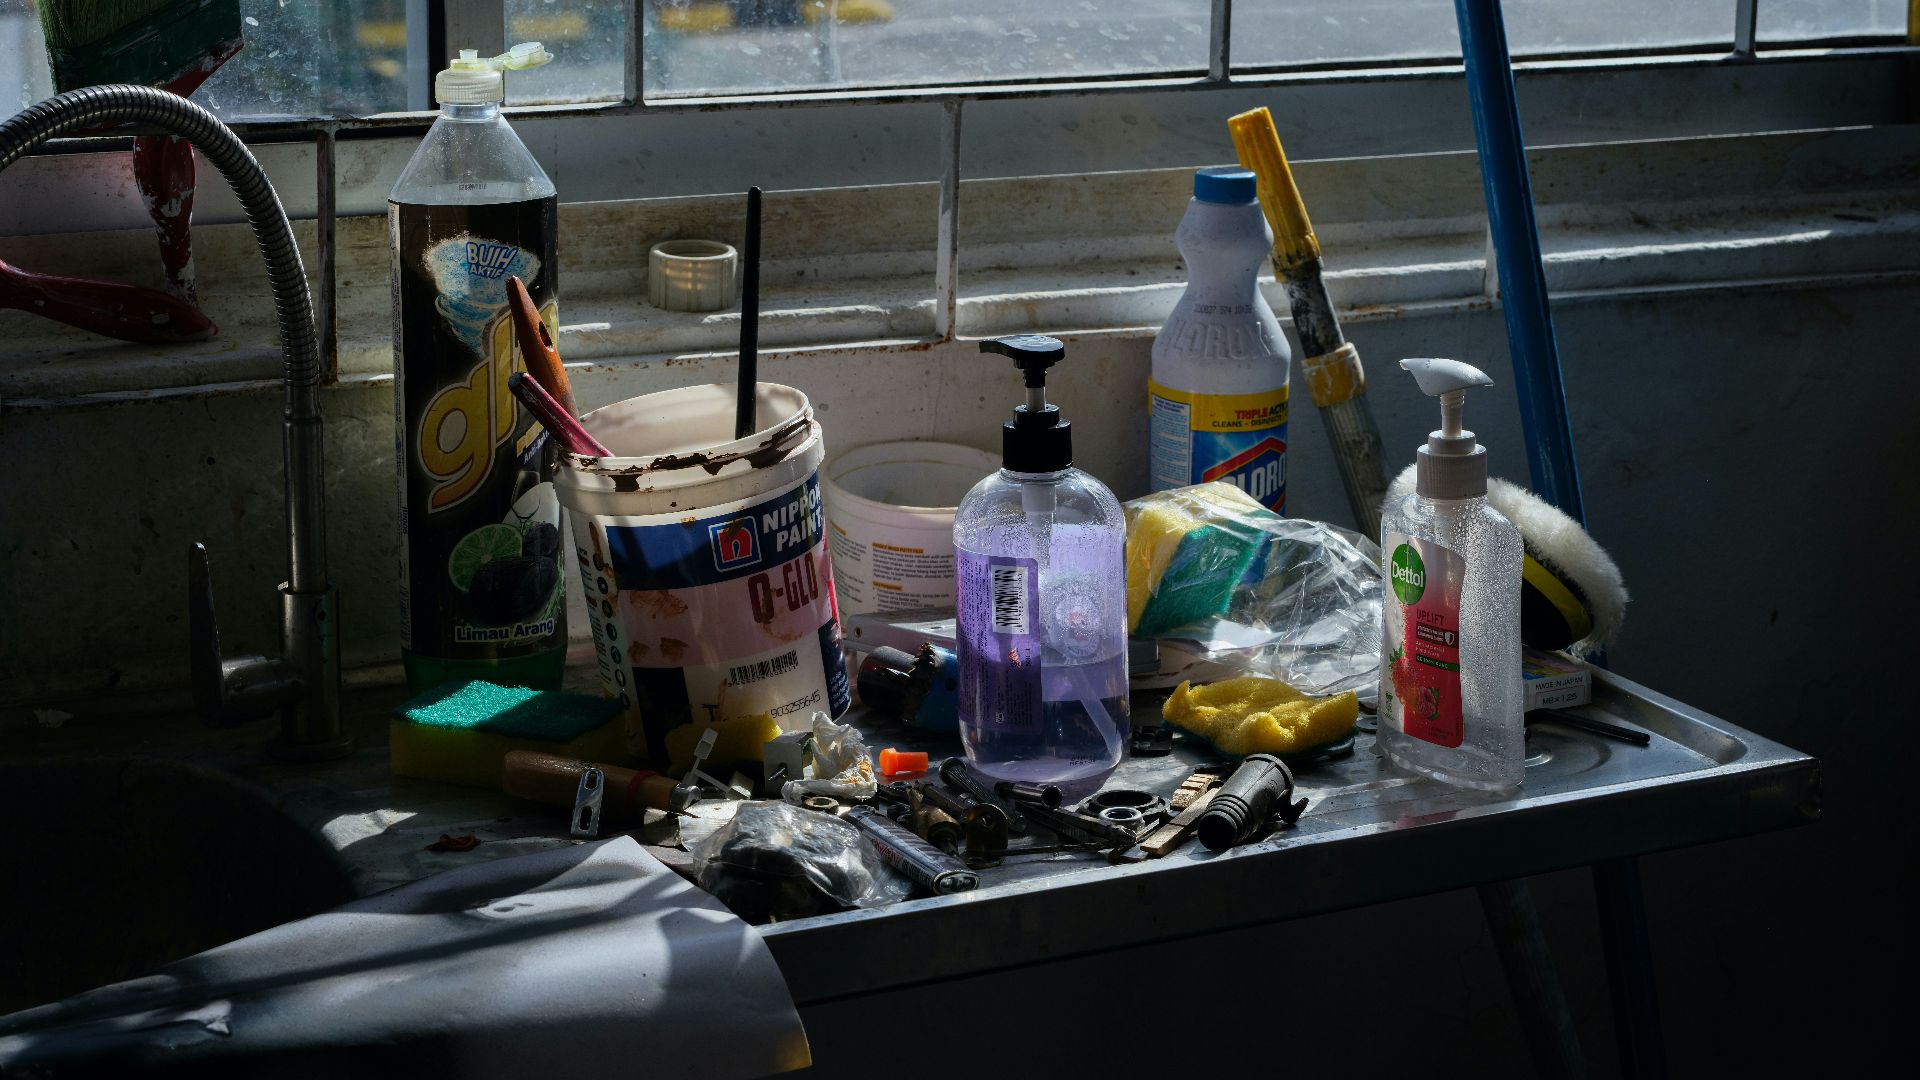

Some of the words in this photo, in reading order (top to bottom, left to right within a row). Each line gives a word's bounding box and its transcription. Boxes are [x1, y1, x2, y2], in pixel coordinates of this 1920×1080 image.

[466, 242, 519, 270] BUIH
[469, 263, 506, 279] AKTIF
[1212, 420, 1243, 428] CLEANS
[1234, 406, 1269, 421] TRIPLE
[762, 482, 821, 534] NIPPON
[776, 506, 822, 552] PAINT
[1392, 560, 1424, 589] Dettol
[747, 552, 819, 625] Q-GLO
[455, 625, 510, 642] Limau
[514, 617, 554, 639] Arang
[1416, 608, 1445, 625] UPLIFT
